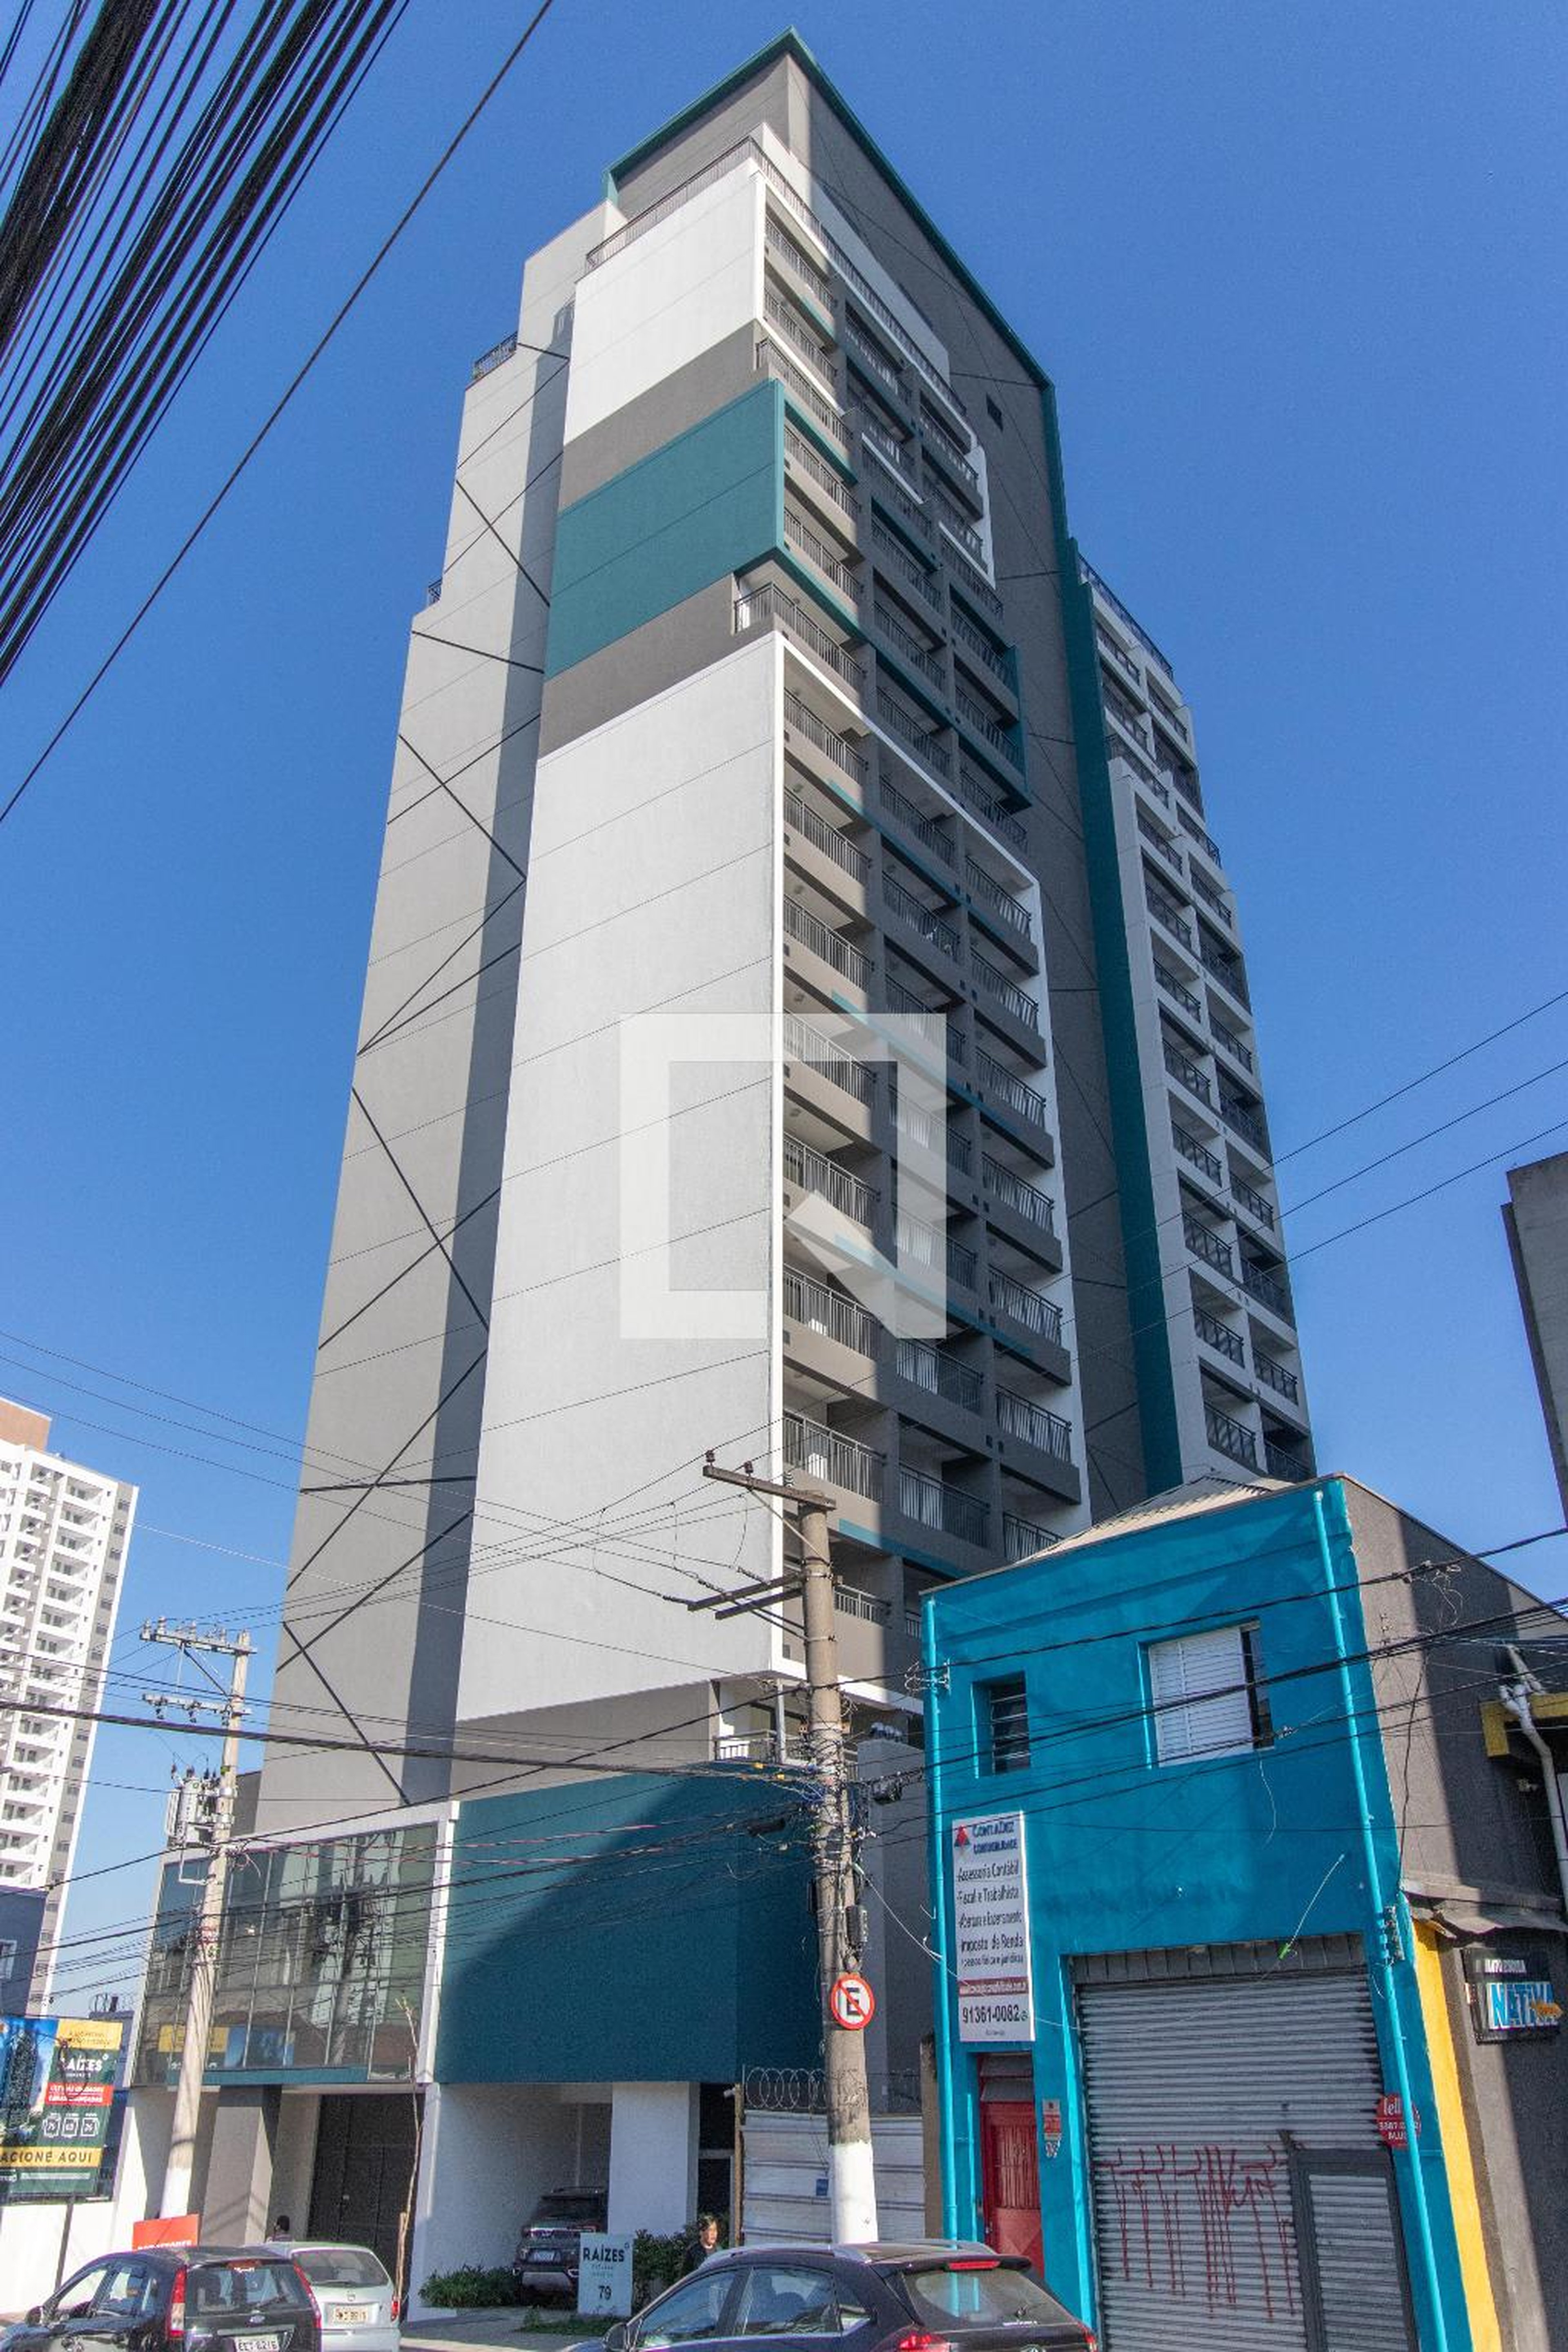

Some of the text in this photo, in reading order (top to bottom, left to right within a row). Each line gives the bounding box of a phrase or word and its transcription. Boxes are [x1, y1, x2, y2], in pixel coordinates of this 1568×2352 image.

[846, 1987, 860, 2016] E
[58, 2151, 92, 2163] AQUI
[583, 2244, 625, 2262] RAÍZES
[599, 2285, 612, 2301] 79
